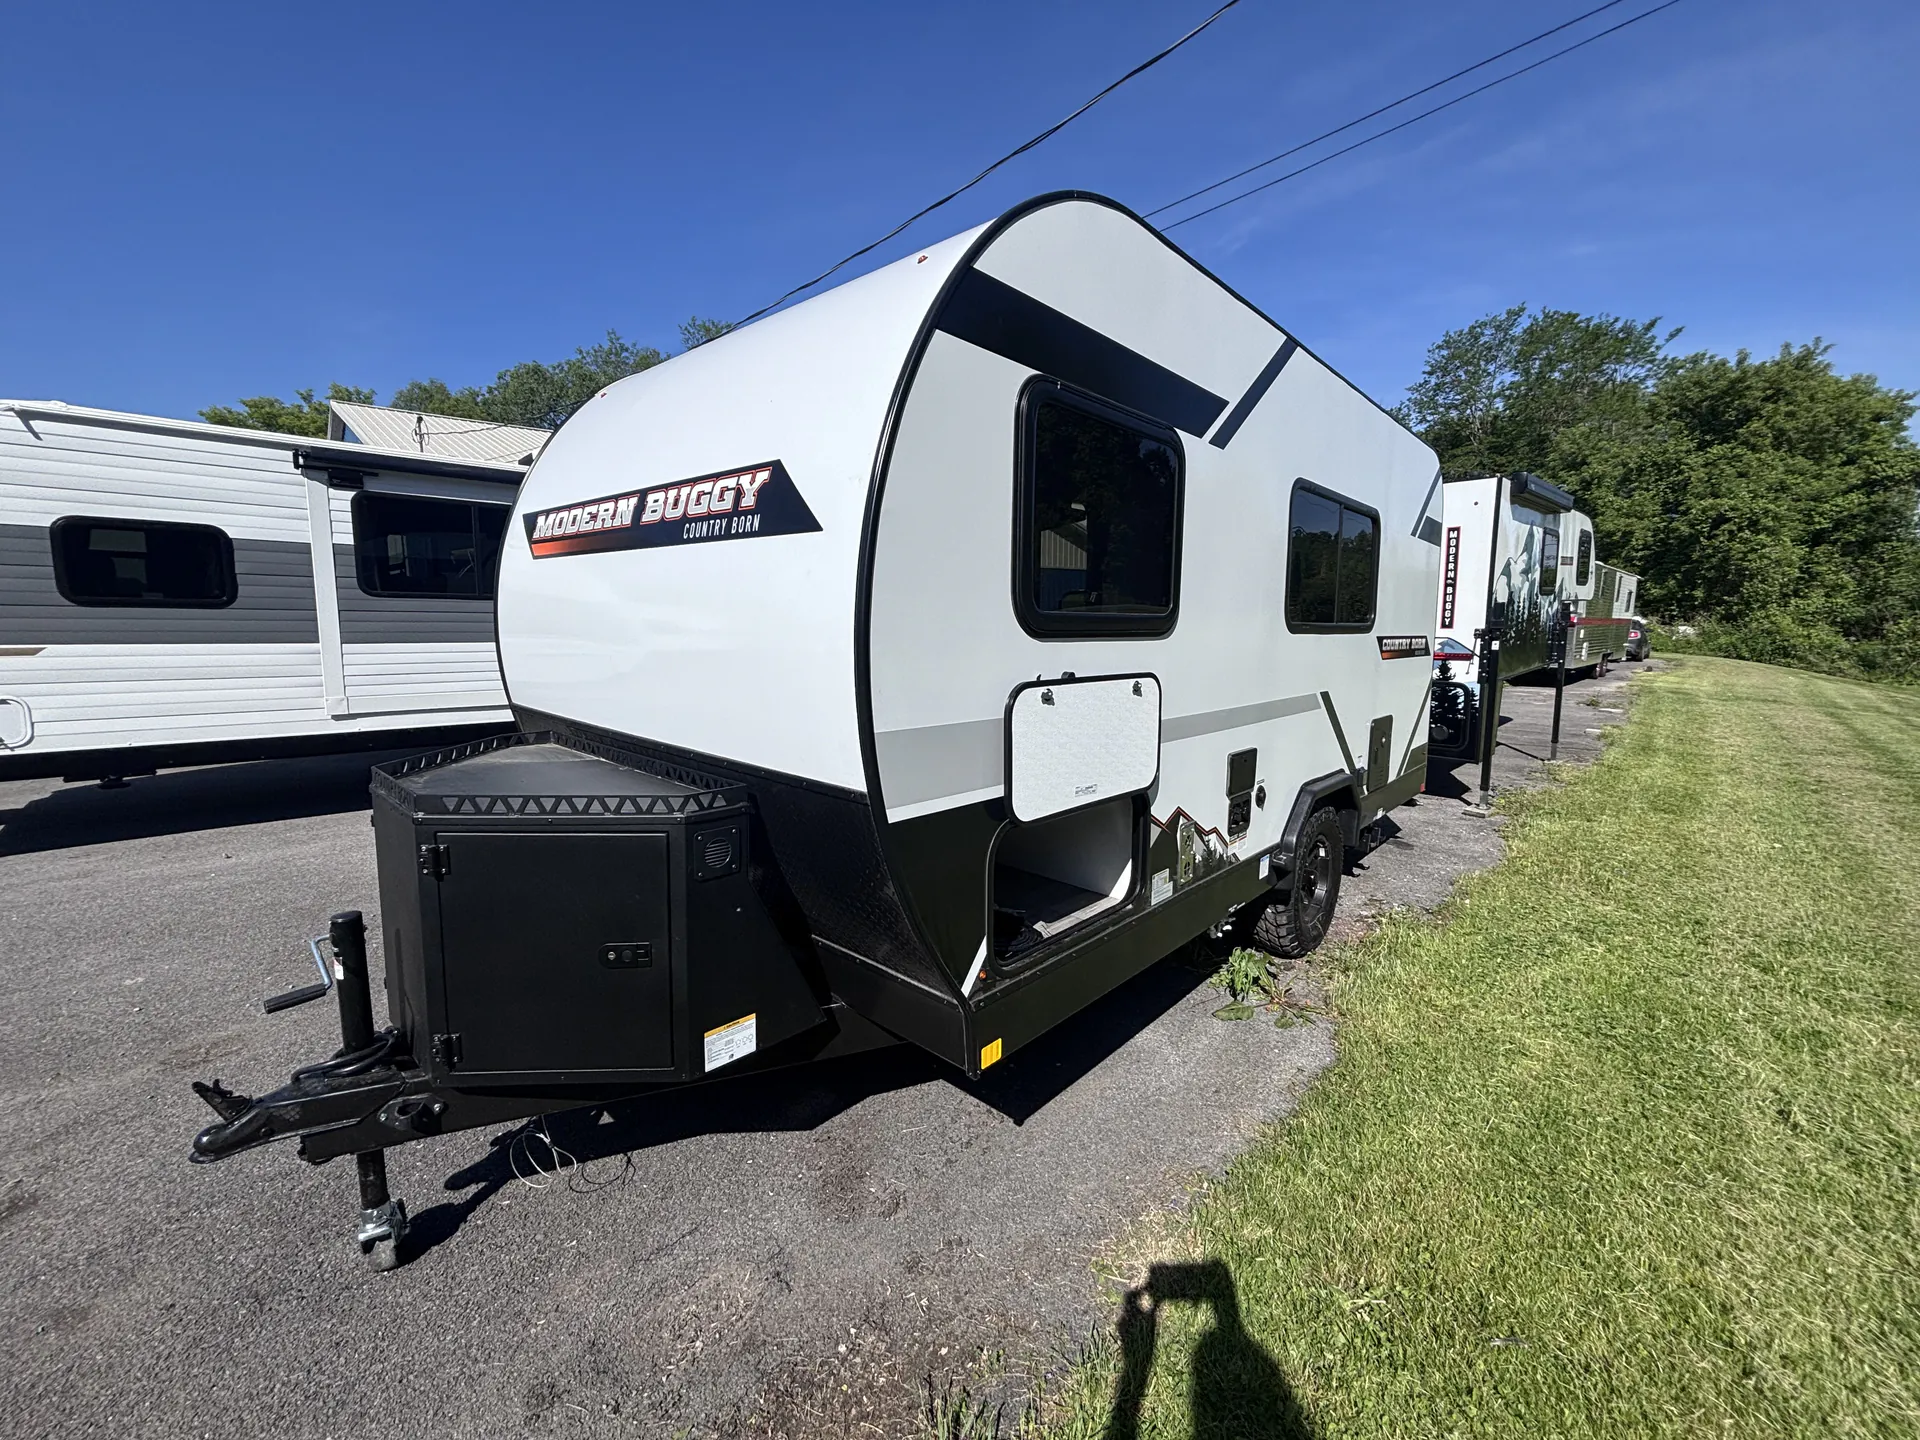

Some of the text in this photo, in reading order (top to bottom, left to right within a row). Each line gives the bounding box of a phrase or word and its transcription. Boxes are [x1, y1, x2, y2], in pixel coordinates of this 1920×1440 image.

[532, 466, 773, 541] MODERN BUGGY
[683, 514, 761, 540] COUNTRY BORN
[1444, 530, 1458, 625] MODERN BUGGY
[1382, 638, 1410, 650] COUNTRY
